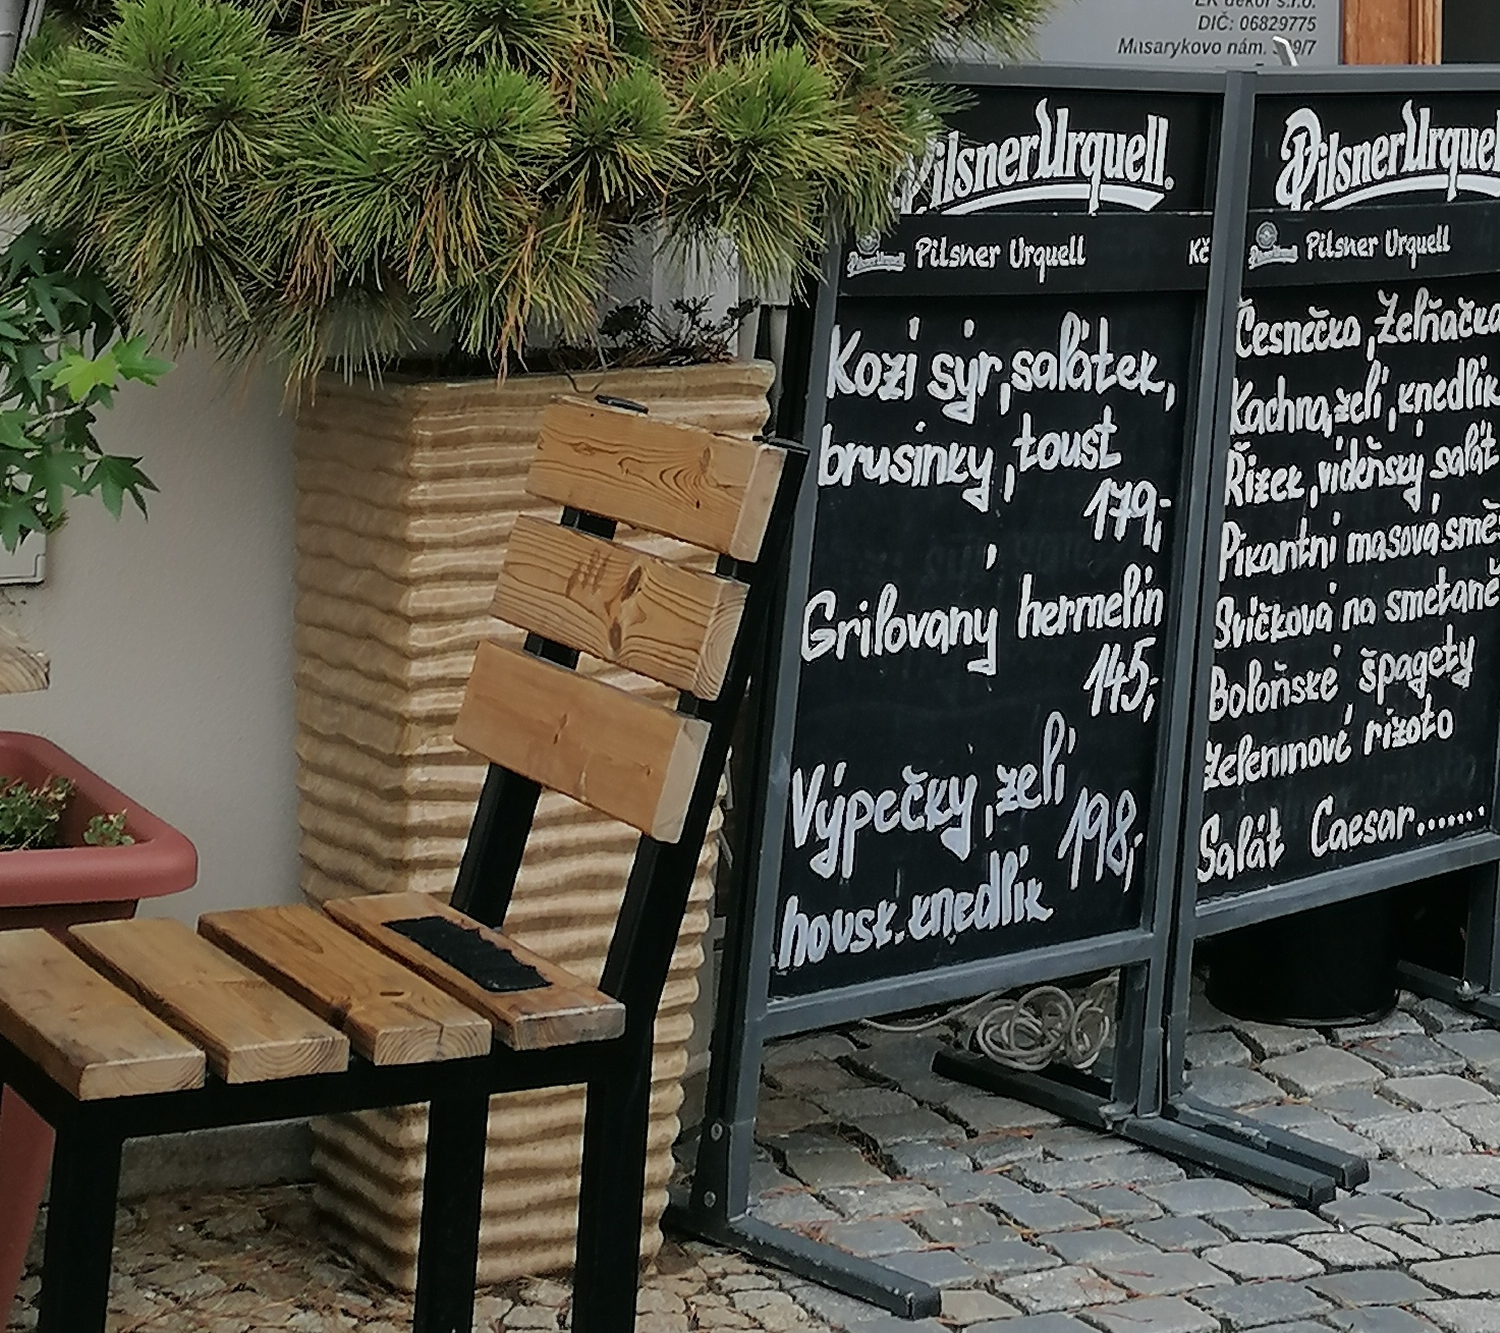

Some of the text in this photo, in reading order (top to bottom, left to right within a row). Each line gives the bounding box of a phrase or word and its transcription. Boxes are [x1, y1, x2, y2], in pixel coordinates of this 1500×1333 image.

[1197, 10, 1318, 32] DIČ: 06829775
[1117, 37, 1318, 59] Masarykovo nám. 9/7
[915, 235, 1002, 269] Pilsner
[1008, 234, 1087, 284] Urquell
[1188, 236, 1211, 266] Kč
[1305, 228, 1379, 261] Pilsner
[1384, 223, 1451, 270] Urquell
[1011, 404, 1122, 472] toust
[1341, 596, 1377, 631] na
[1357, 623, 1476, 705] špagety
[1363, 693, 1454, 755] rizoto
